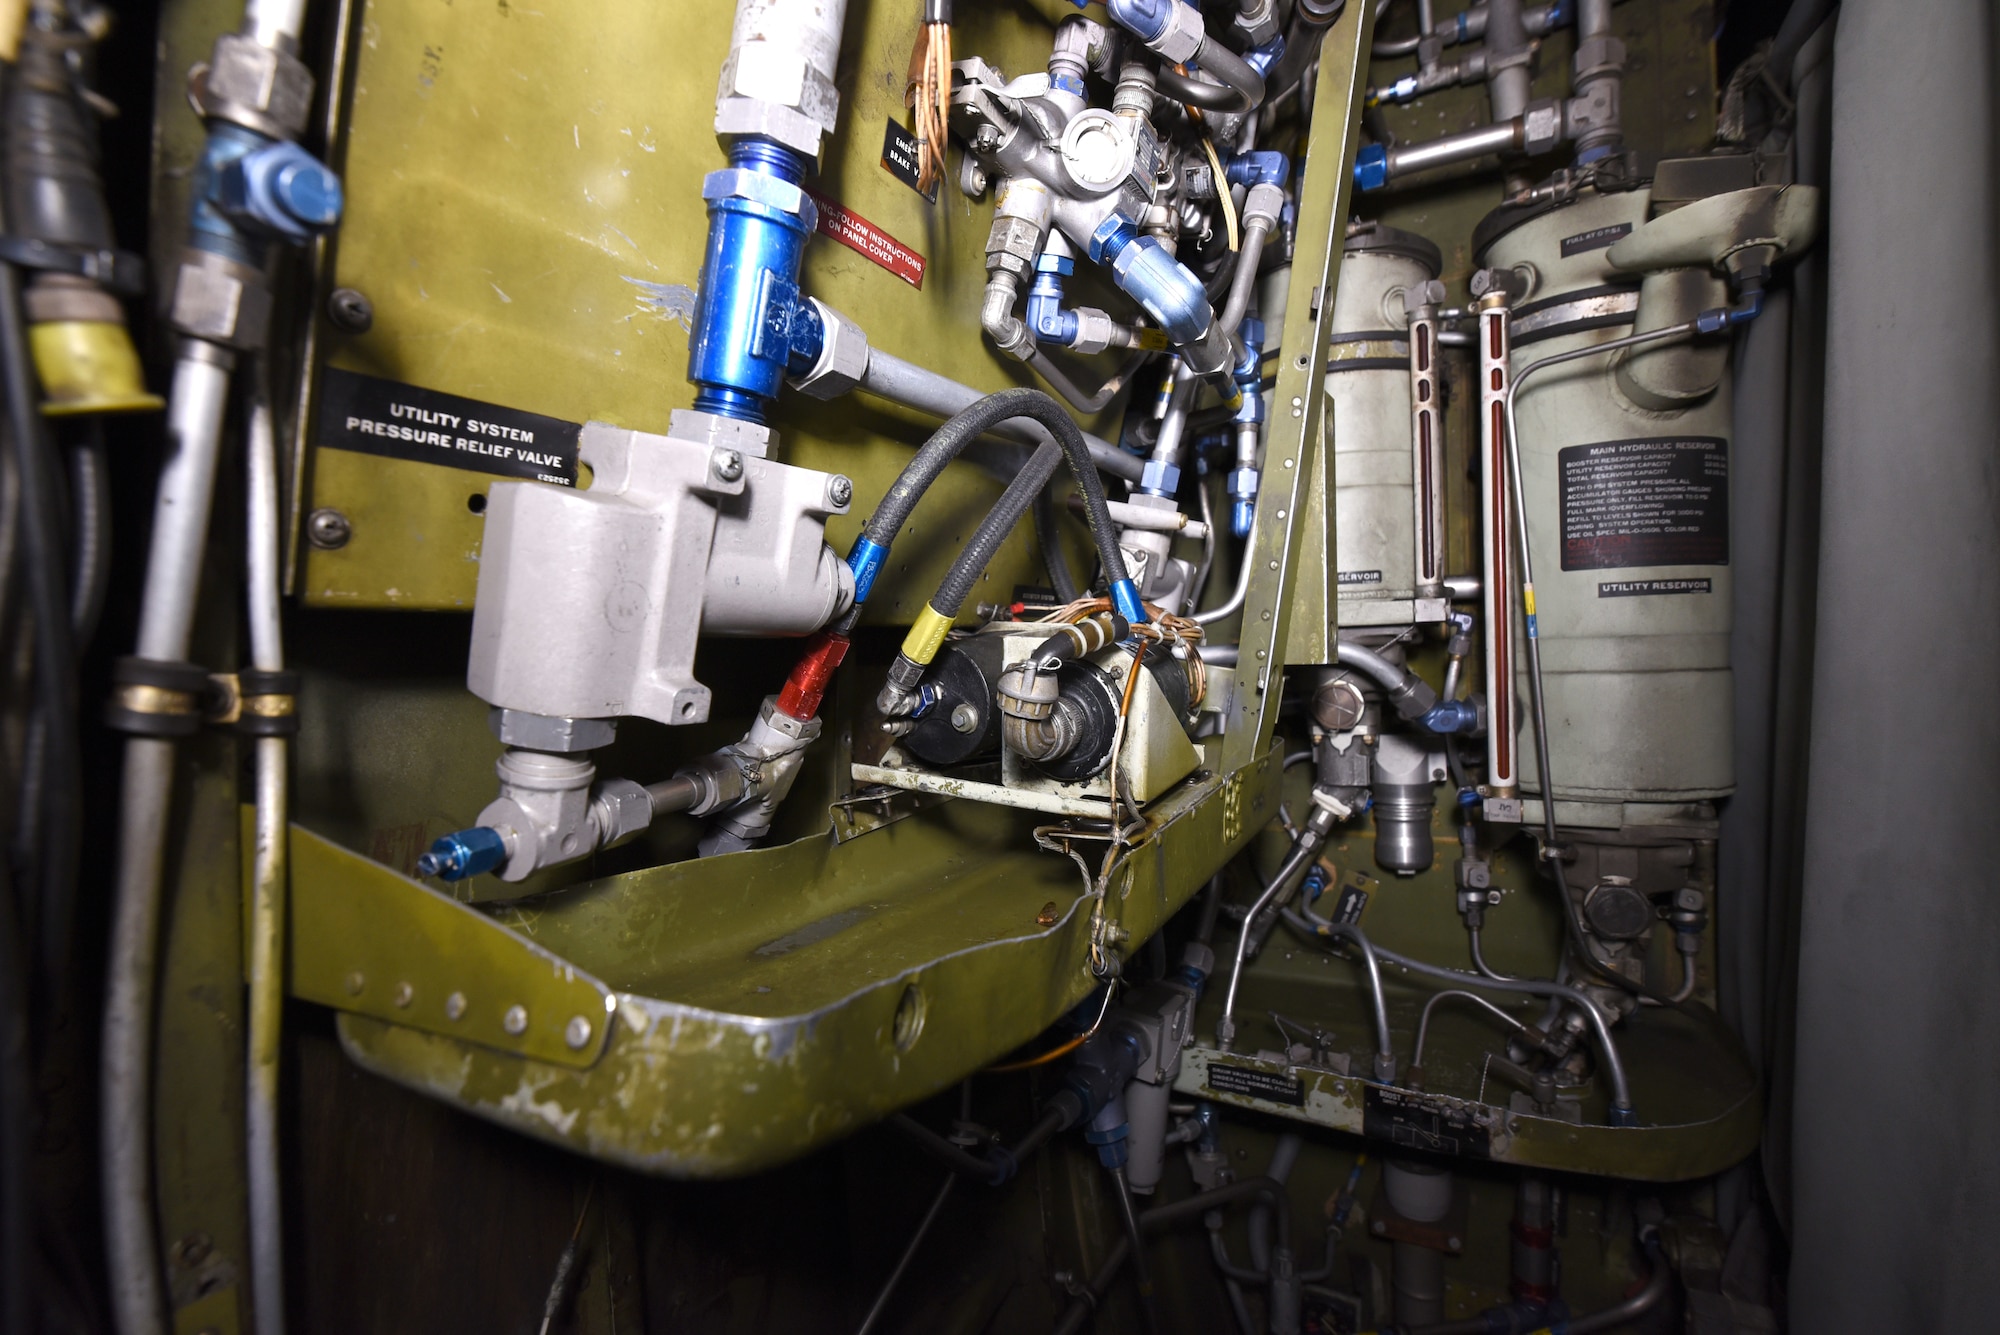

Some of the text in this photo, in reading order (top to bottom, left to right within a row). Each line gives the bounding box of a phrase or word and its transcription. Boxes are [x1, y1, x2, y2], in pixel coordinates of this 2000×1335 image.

[890, 149, 911, 171] BRAKE
[812, 196, 922, 272] NING-FOLLOW INSTRUCTIONS
[828, 220, 893, 264] ON PANEL COVER
[1566, 236, 1584, 246] FULL
[390, 402, 534, 444] UTILITY SYSTEM
[346, 416, 562, 469] PRESSURE RELIEF VALVE
[1590, 441, 1716, 456] MAIN HYDRAULIC RESERVOIR
[1566, 458, 1600, 468] BOOSTER
[1601, 454, 1642, 464] RESERVOIR
[1566, 460, 1671, 476] UTILITY RESERVOIR CAPACITY
[1567, 475, 1590, 483] TOTAL
[1591, 470, 1633, 480] RESERVOIR
[1567, 485, 1586, 493] WITH
[1607, 480, 1638, 488] SYSTEM
[1567, 489, 1621, 500] ACCUMULATOR
[1622, 487, 1652, 495] GAUGES
[1566, 498, 1605, 508] PRESSURE
[1566, 508, 1584, 516] FULL
[1585, 506, 1607, 514] MARK
[1603, 512, 1631, 520] LEVELS
[1632, 510, 1660, 518] SHOWN
[1567, 523, 1594, 531] DURING
[1598, 520, 1629, 528] SYSTEM
[1567, 531, 1582, 539] USE
[1567, 535, 1631, 551] CAUTION
[1338, 572, 1379, 581] SERVOIR
[1602, 581, 1709, 592] UTILITY RESERVOIR
[1211, 1067, 1232, 1075] DRAIN
[1232, 1071, 1251, 1079] VALVE
[1211, 1073, 1234, 1082] UNDER
[1247, 1080, 1274, 1090] NORMAL
[1274, 1086, 1297, 1096] FLIGHT
[1211, 1080, 1250, 1092] CONDITIONS
[1378, 1089, 1402, 1101] BOOST
